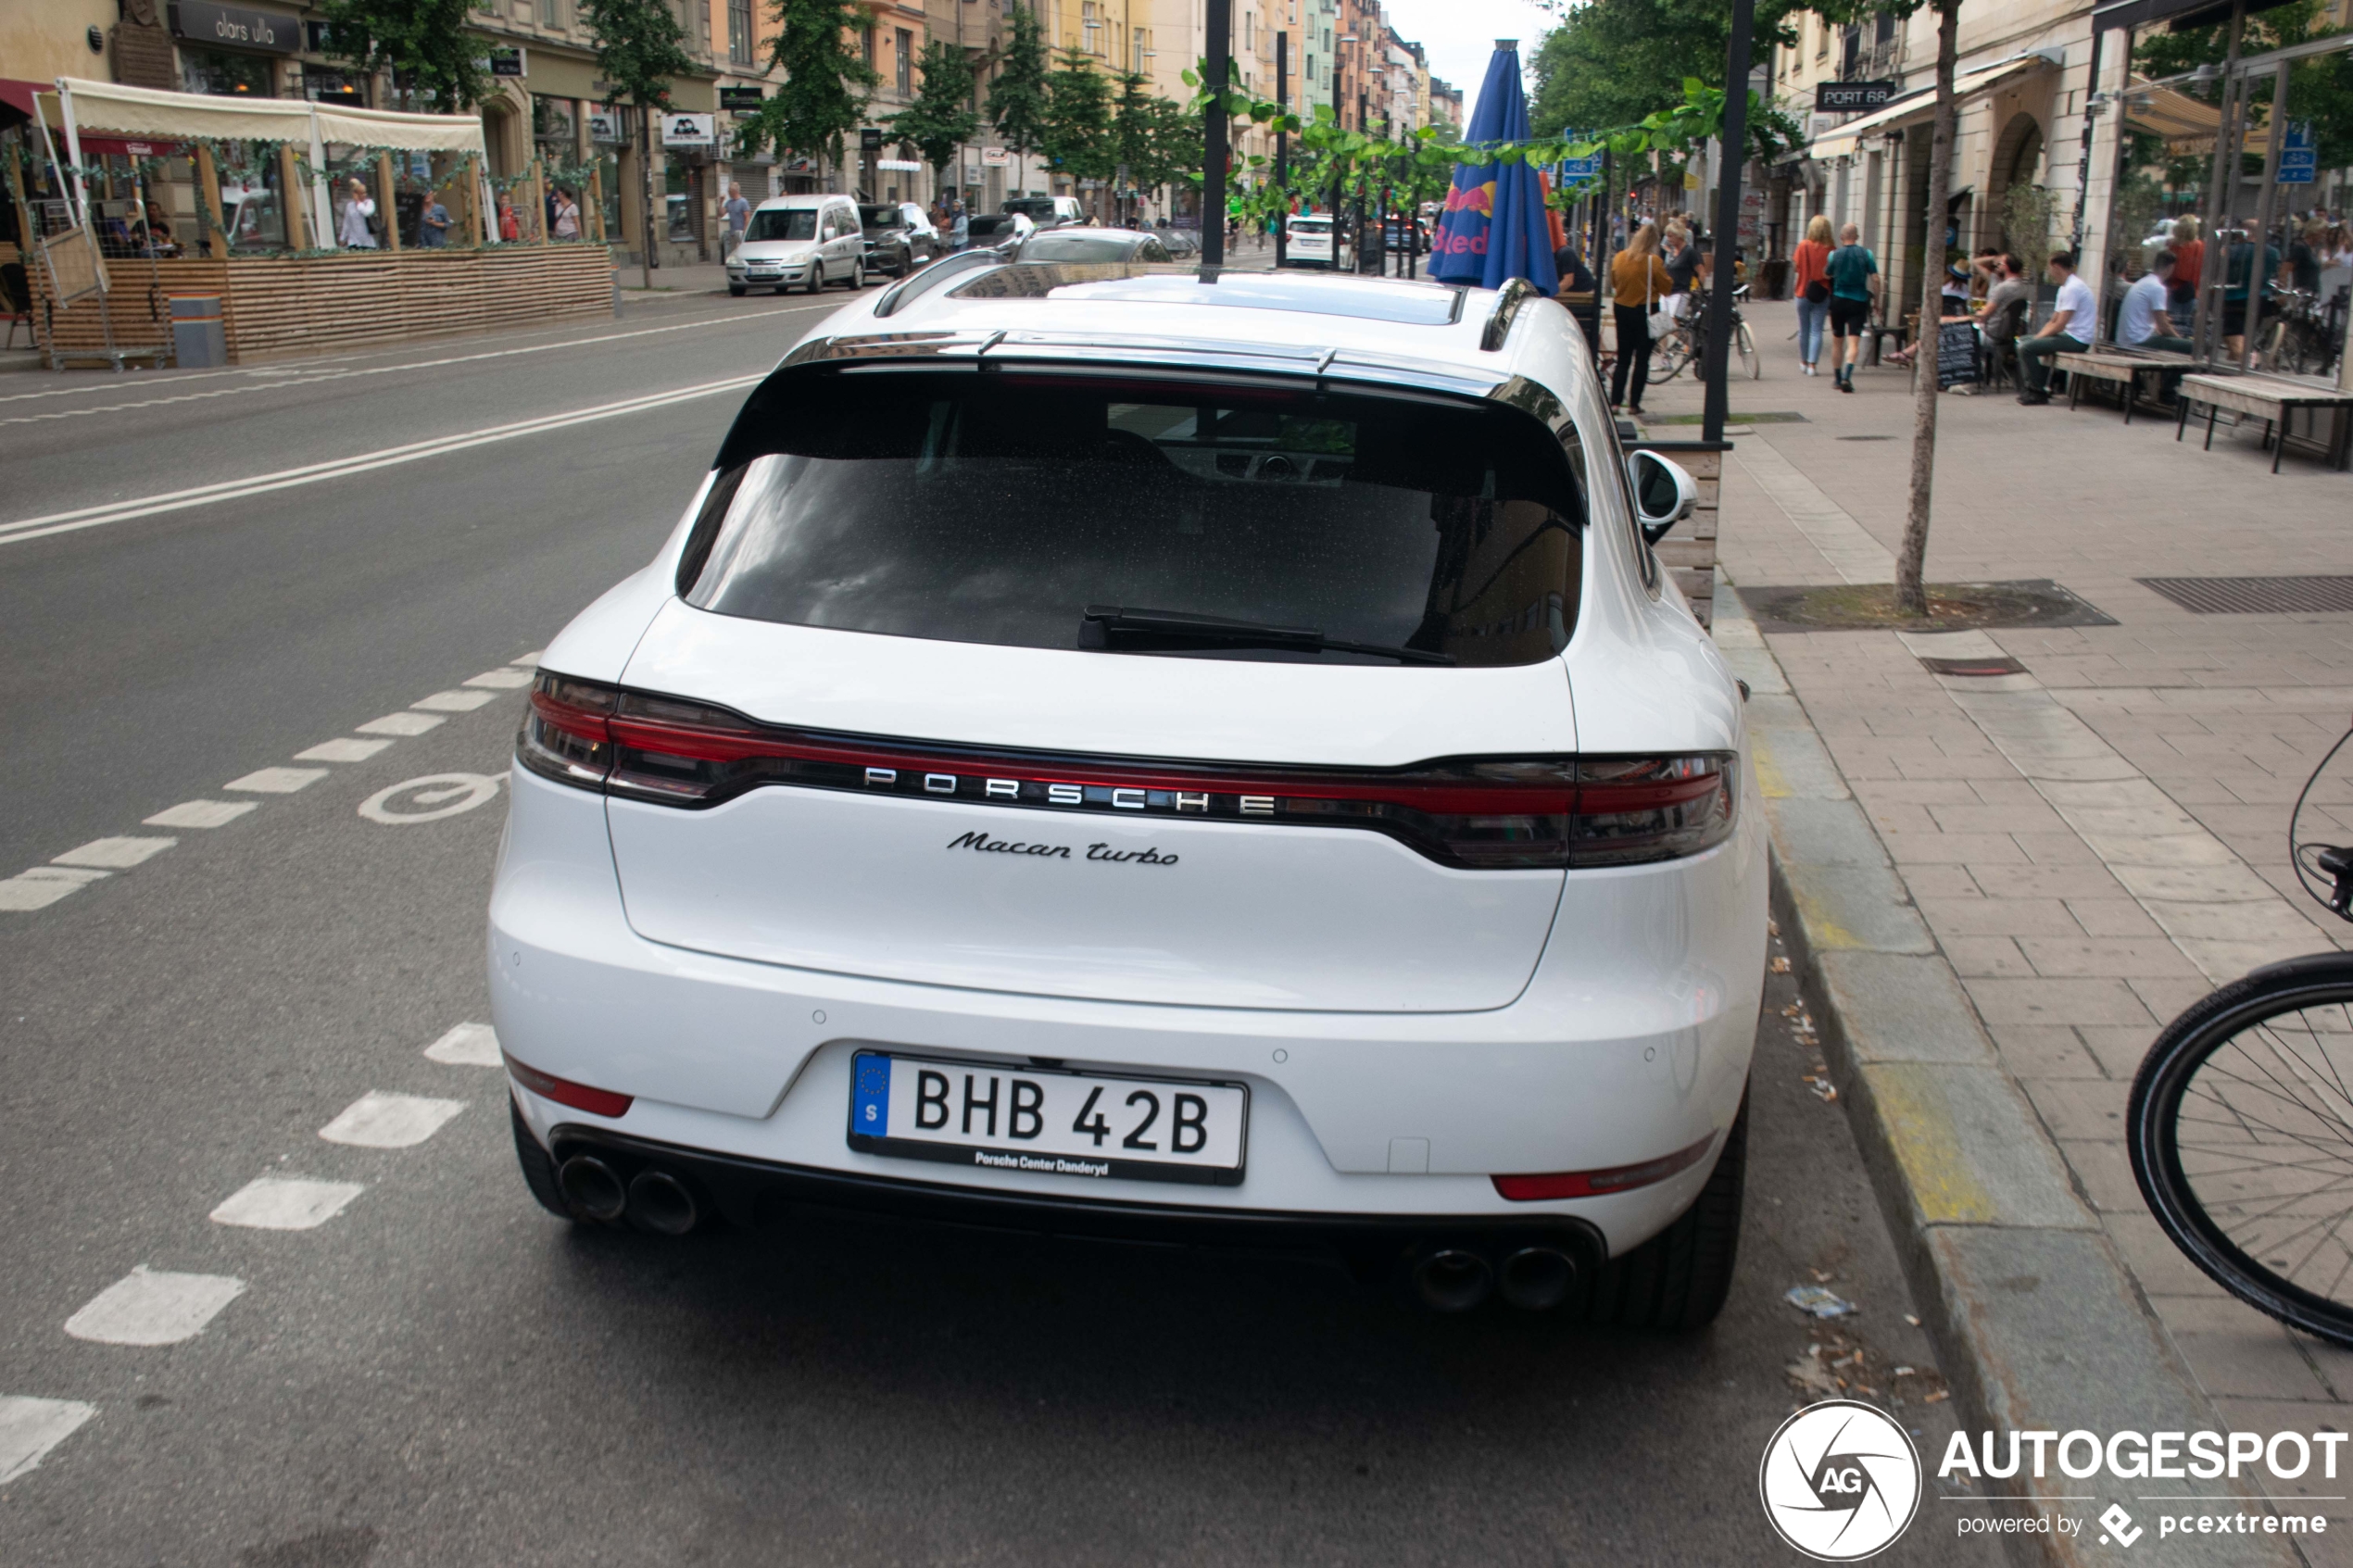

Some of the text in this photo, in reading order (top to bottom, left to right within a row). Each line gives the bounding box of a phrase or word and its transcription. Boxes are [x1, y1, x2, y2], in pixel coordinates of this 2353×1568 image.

[1824, 91, 1888, 104] PORT 68
[864, 767, 1275, 815] PORSCHE
[947, 831, 1180, 866] Macan turbo
[865, 1104, 878, 1123] S
[915, 1070, 1209, 1154] BHB 42B
[975, 1151, 1109, 1177] Porsche Center Danderyd
